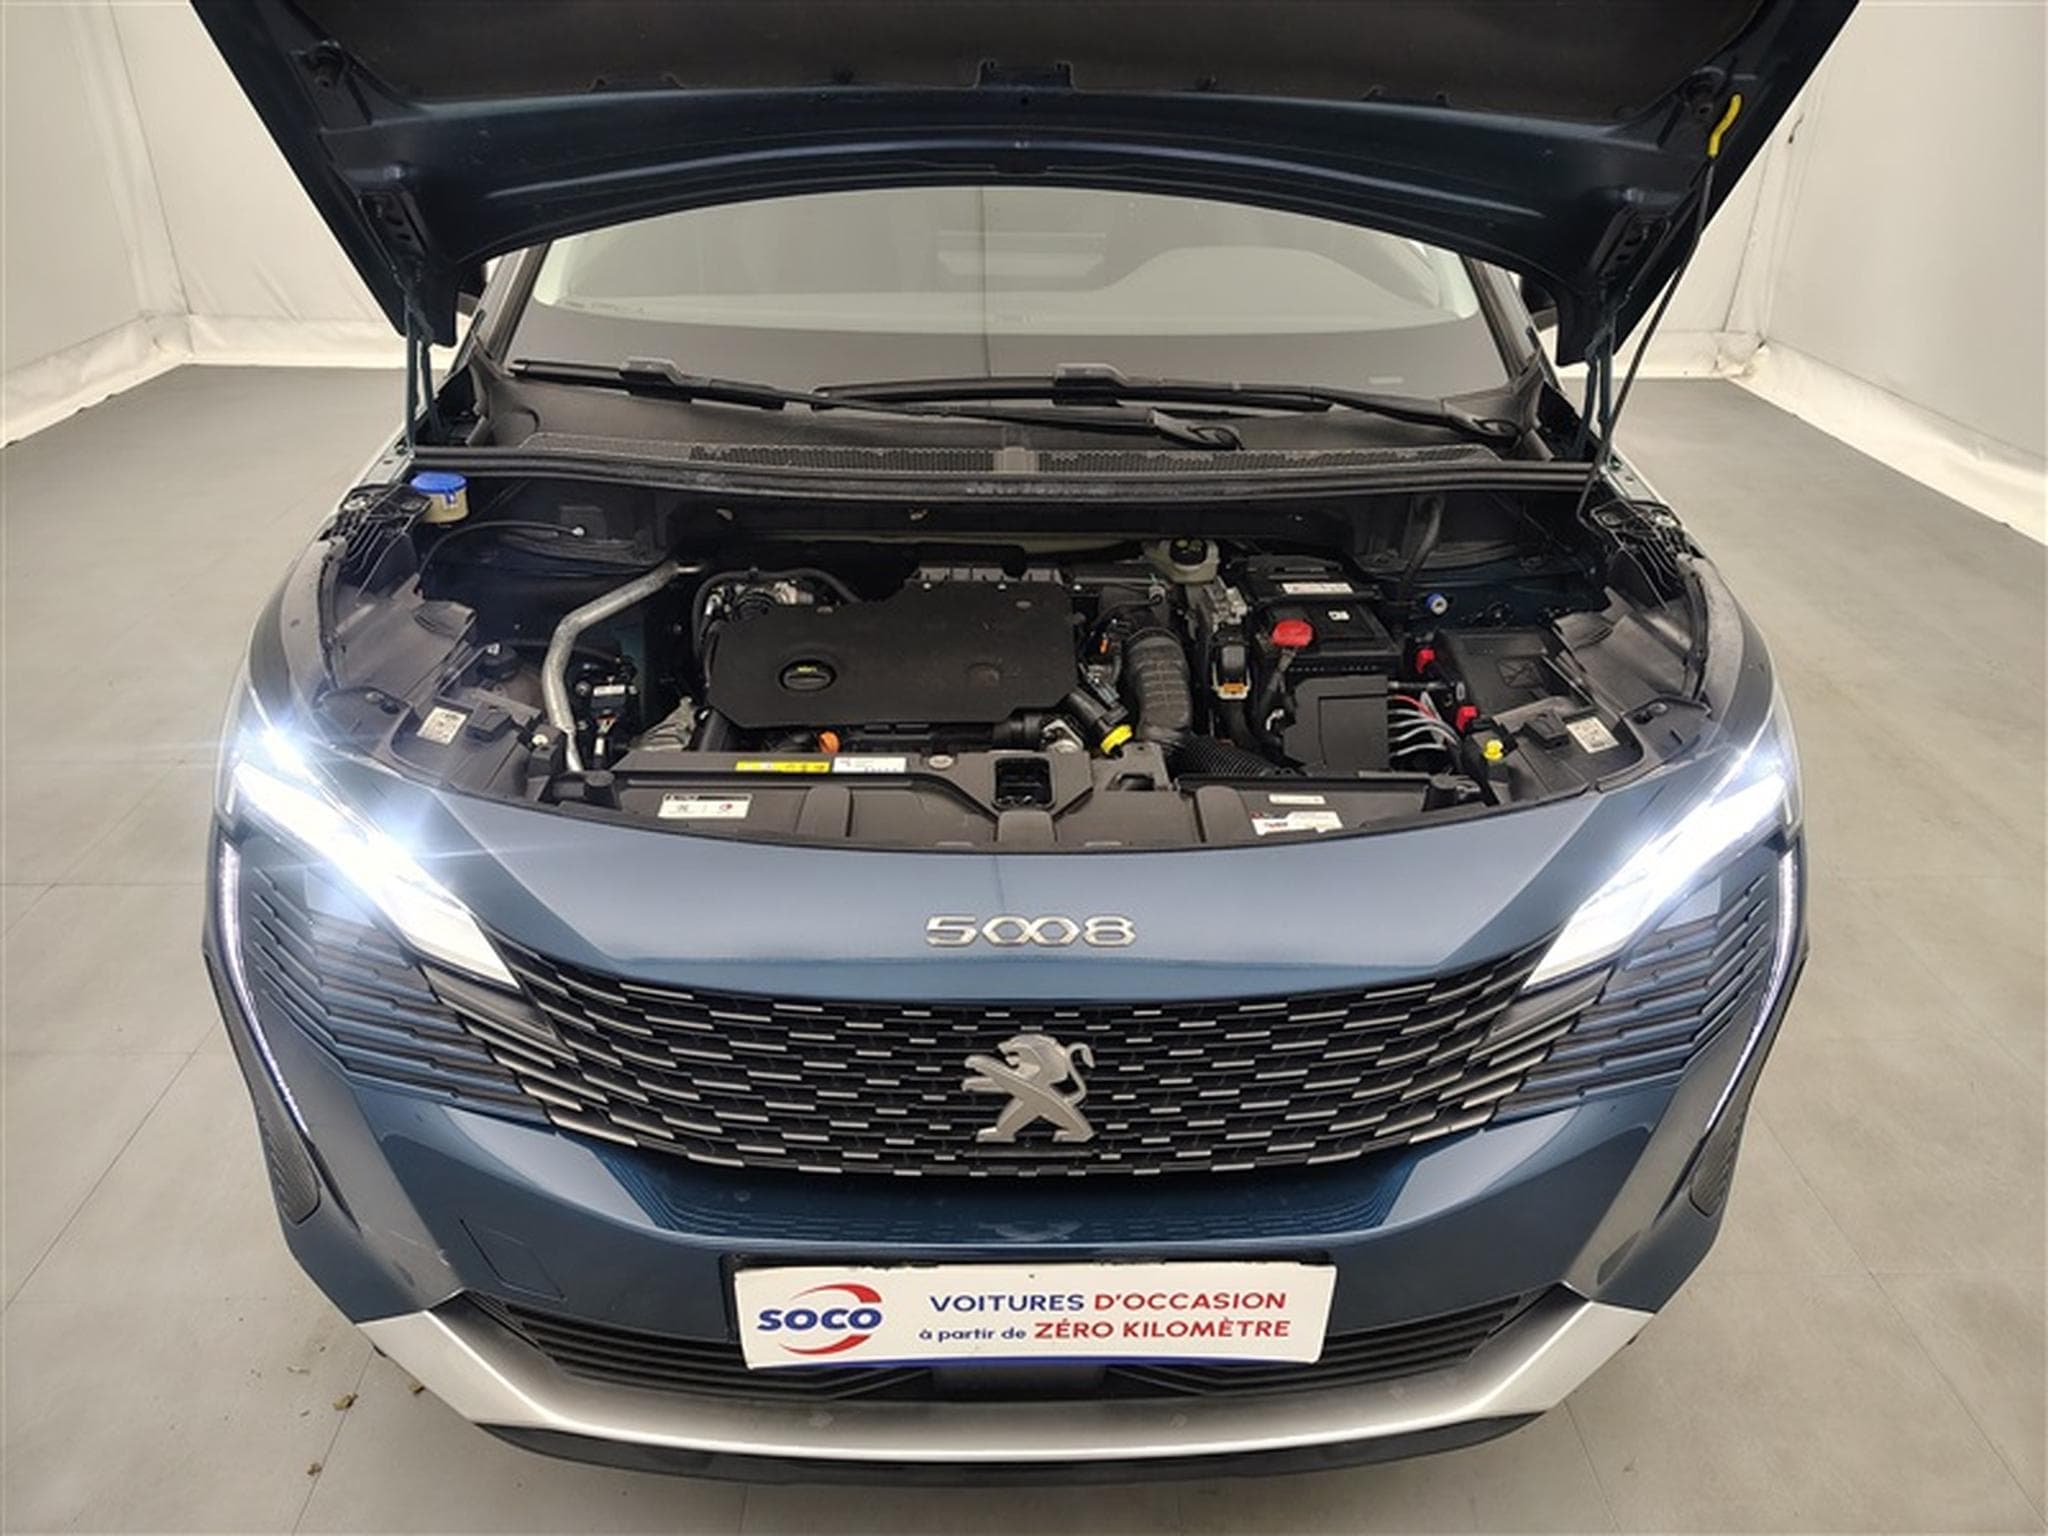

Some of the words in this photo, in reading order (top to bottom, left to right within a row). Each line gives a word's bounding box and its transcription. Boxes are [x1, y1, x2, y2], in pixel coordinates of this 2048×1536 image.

[926, 916, 1136, 947] 5008
[930, 1294, 1084, 1312] VOITURES
[1094, 1292, 1286, 1310] D'OCCASION
[757, 1308, 882, 1331] SOCO
[919, 1328, 932, 1340] à
[938, 1327, 995, 1342] partir
[1001, 1327, 1026, 1340] de
[1034, 1318, 1114, 1339] ZÉRO
[1123, 1316, 1290, 1337] KILOMÈTRE
